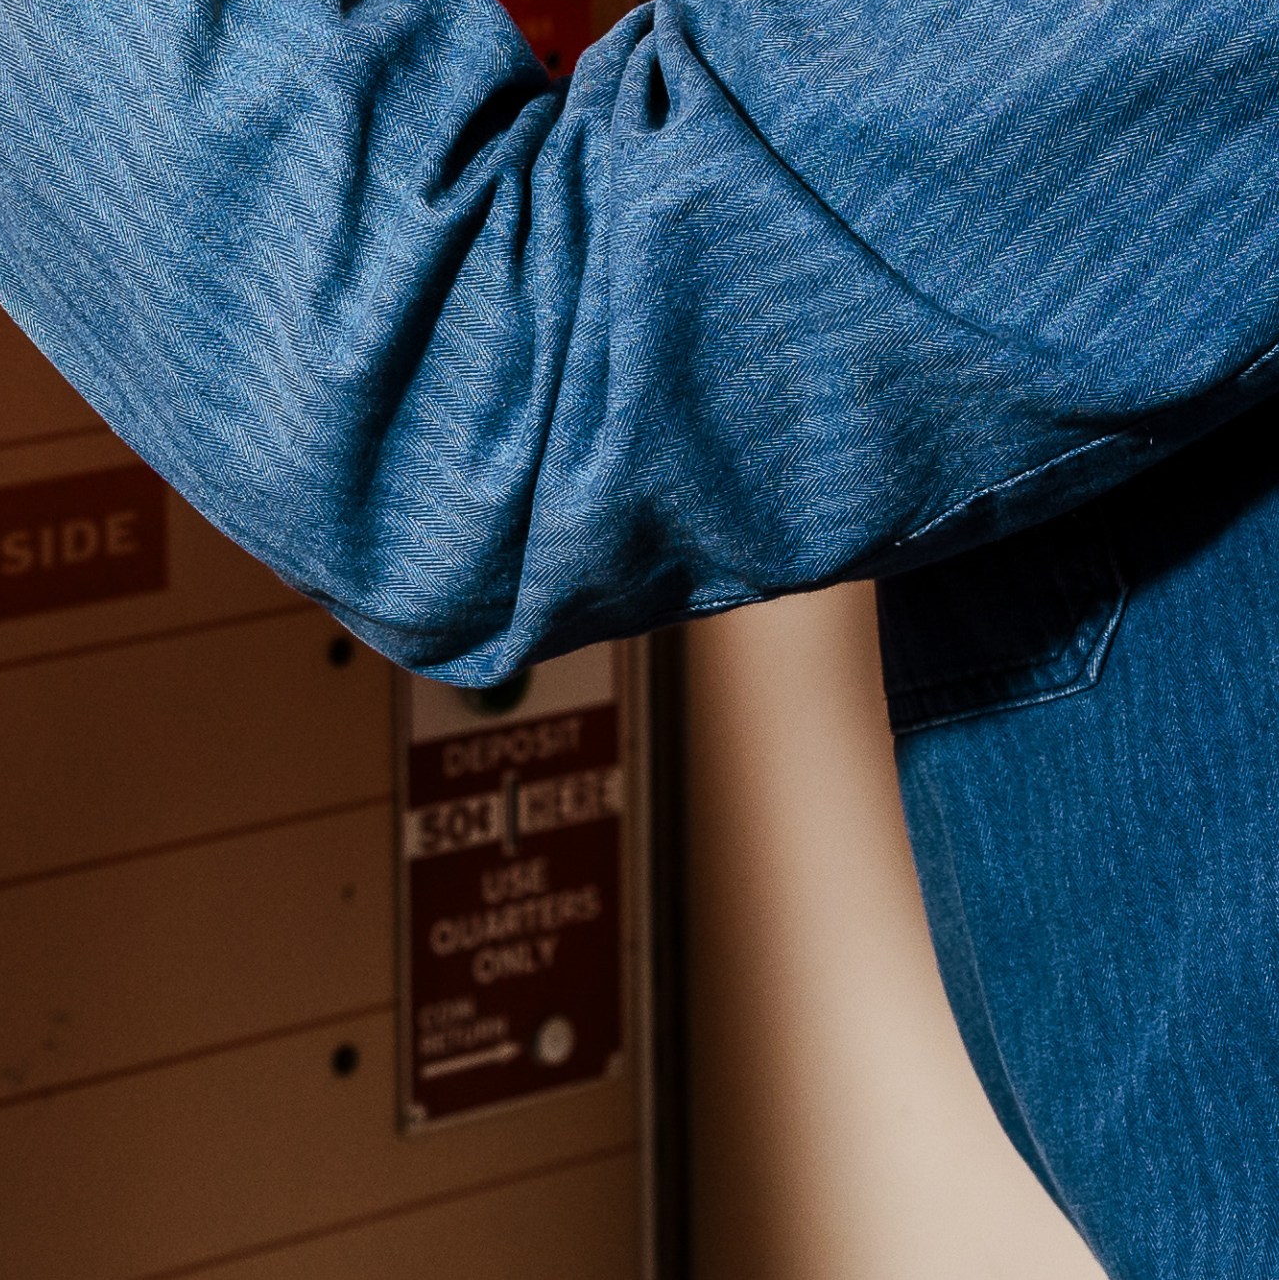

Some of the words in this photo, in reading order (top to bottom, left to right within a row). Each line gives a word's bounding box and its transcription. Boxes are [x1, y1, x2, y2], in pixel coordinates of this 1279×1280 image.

[441, 717, 582, 779] DEPOSIT
[481, 855, 546, 904] USE
[428, 884, 601, 956] QUARTERS
[471, 936, 558, 984] ONLY
